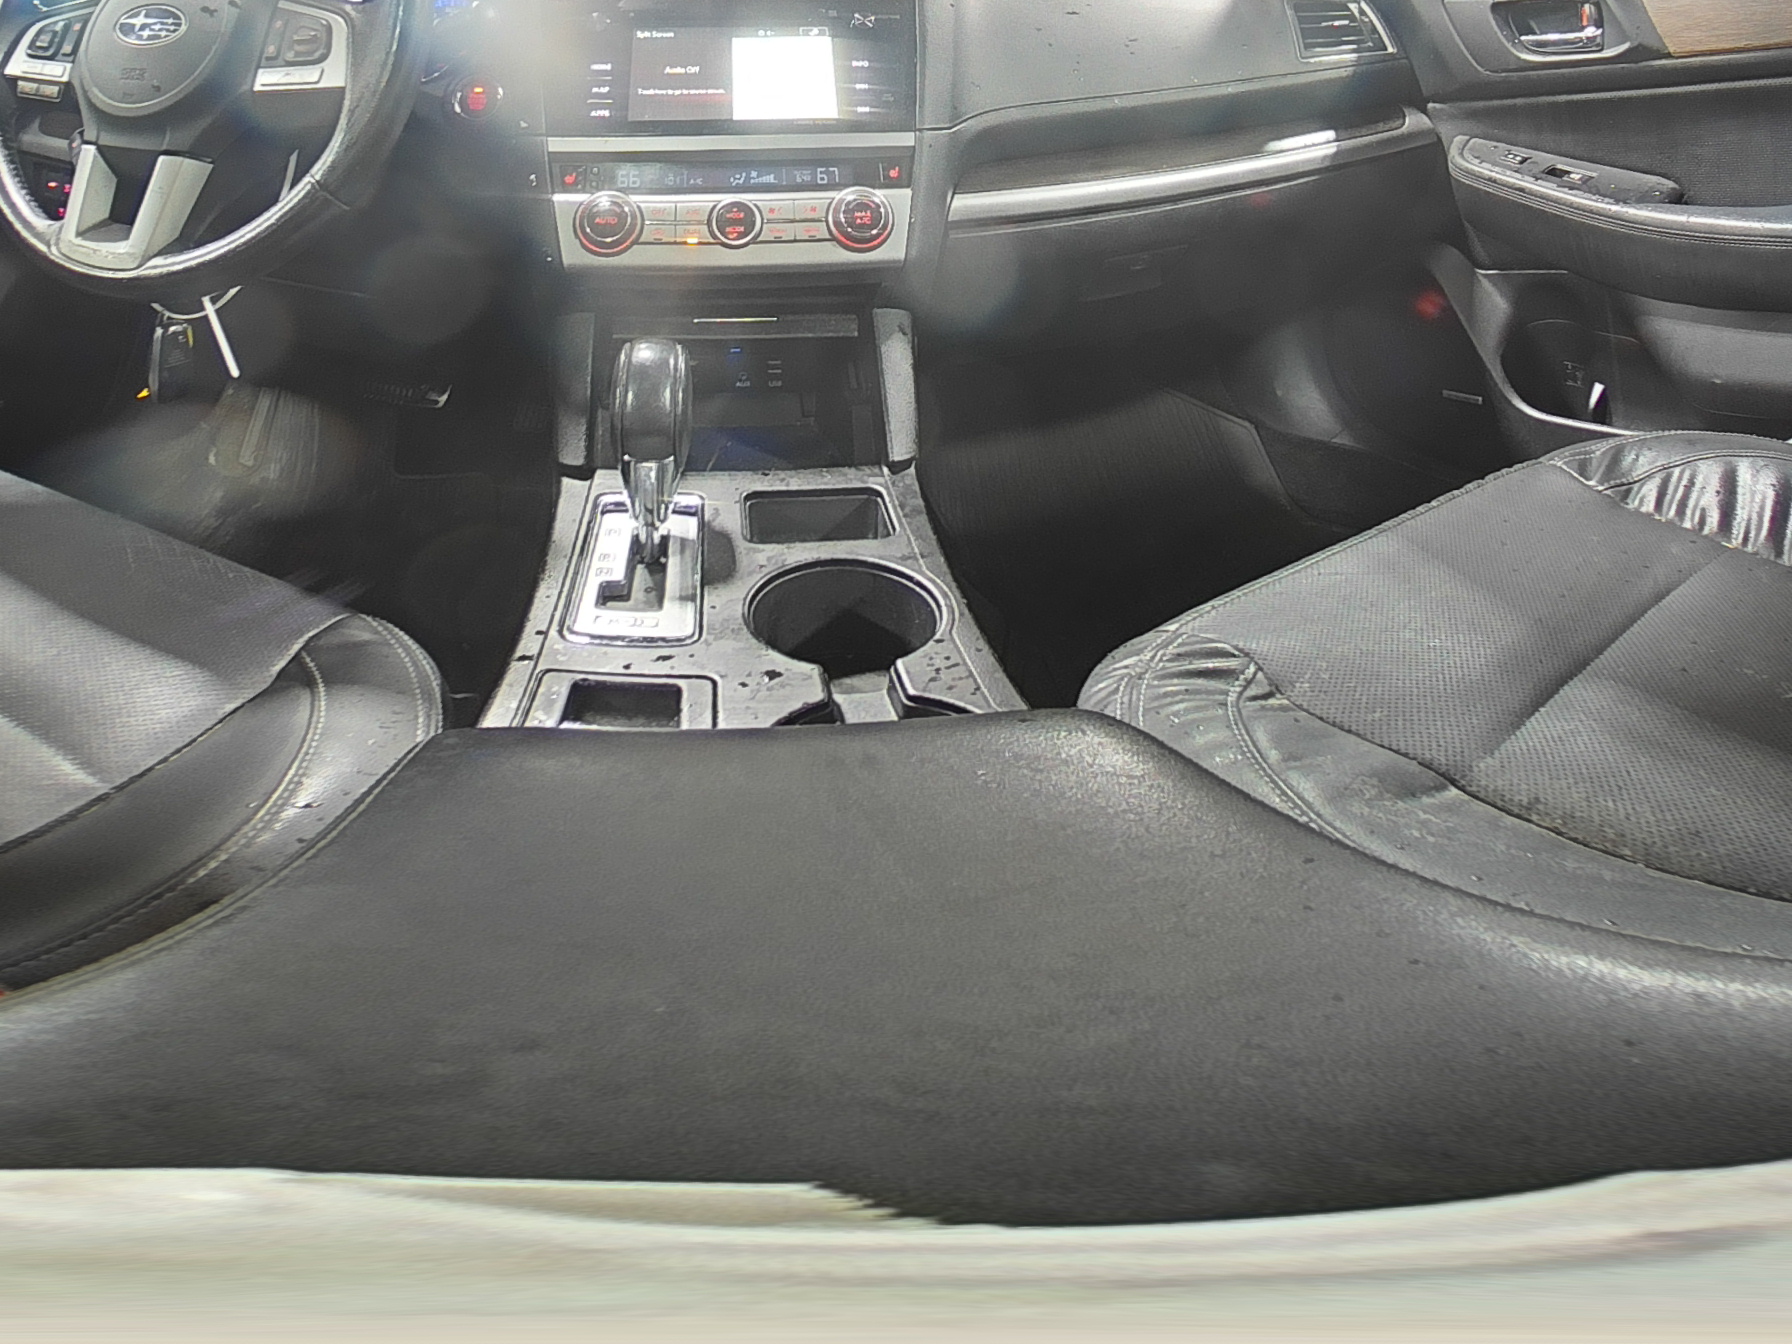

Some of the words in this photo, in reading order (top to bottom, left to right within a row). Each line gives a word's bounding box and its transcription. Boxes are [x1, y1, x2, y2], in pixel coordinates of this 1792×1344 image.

[617, 171, 641, 188] 66
[816, 167, 839, 185] 67
[594, 216, 618, 224] AUTO
